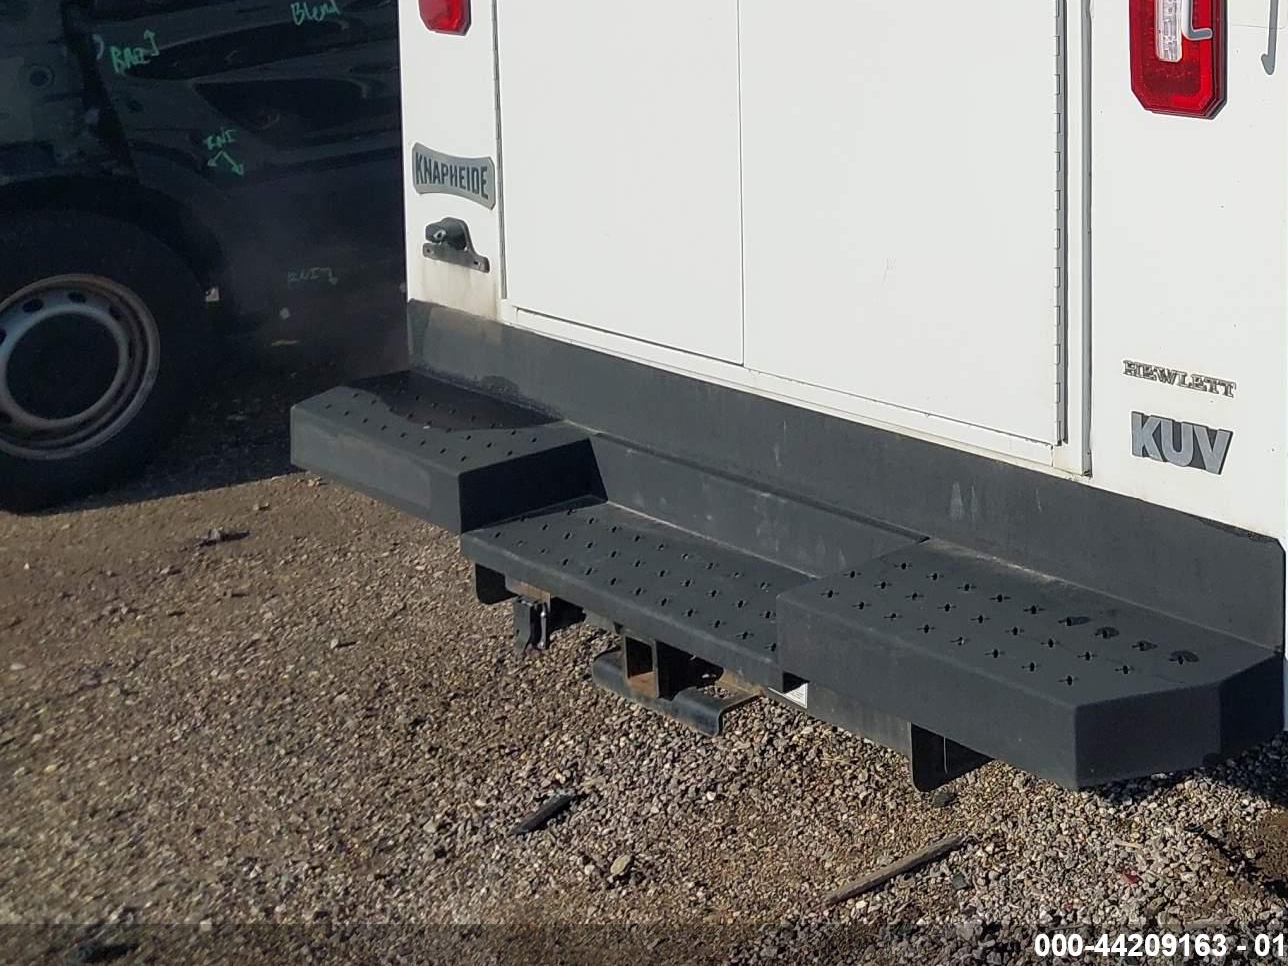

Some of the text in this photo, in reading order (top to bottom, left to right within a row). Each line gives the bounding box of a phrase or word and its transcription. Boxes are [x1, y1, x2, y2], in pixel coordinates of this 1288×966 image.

[415, 152, 489, 201] KNAPHEIDE
[1122, 359, 1237, 398] HEWLETT
[1131, 410, 1234, 475] KUV
